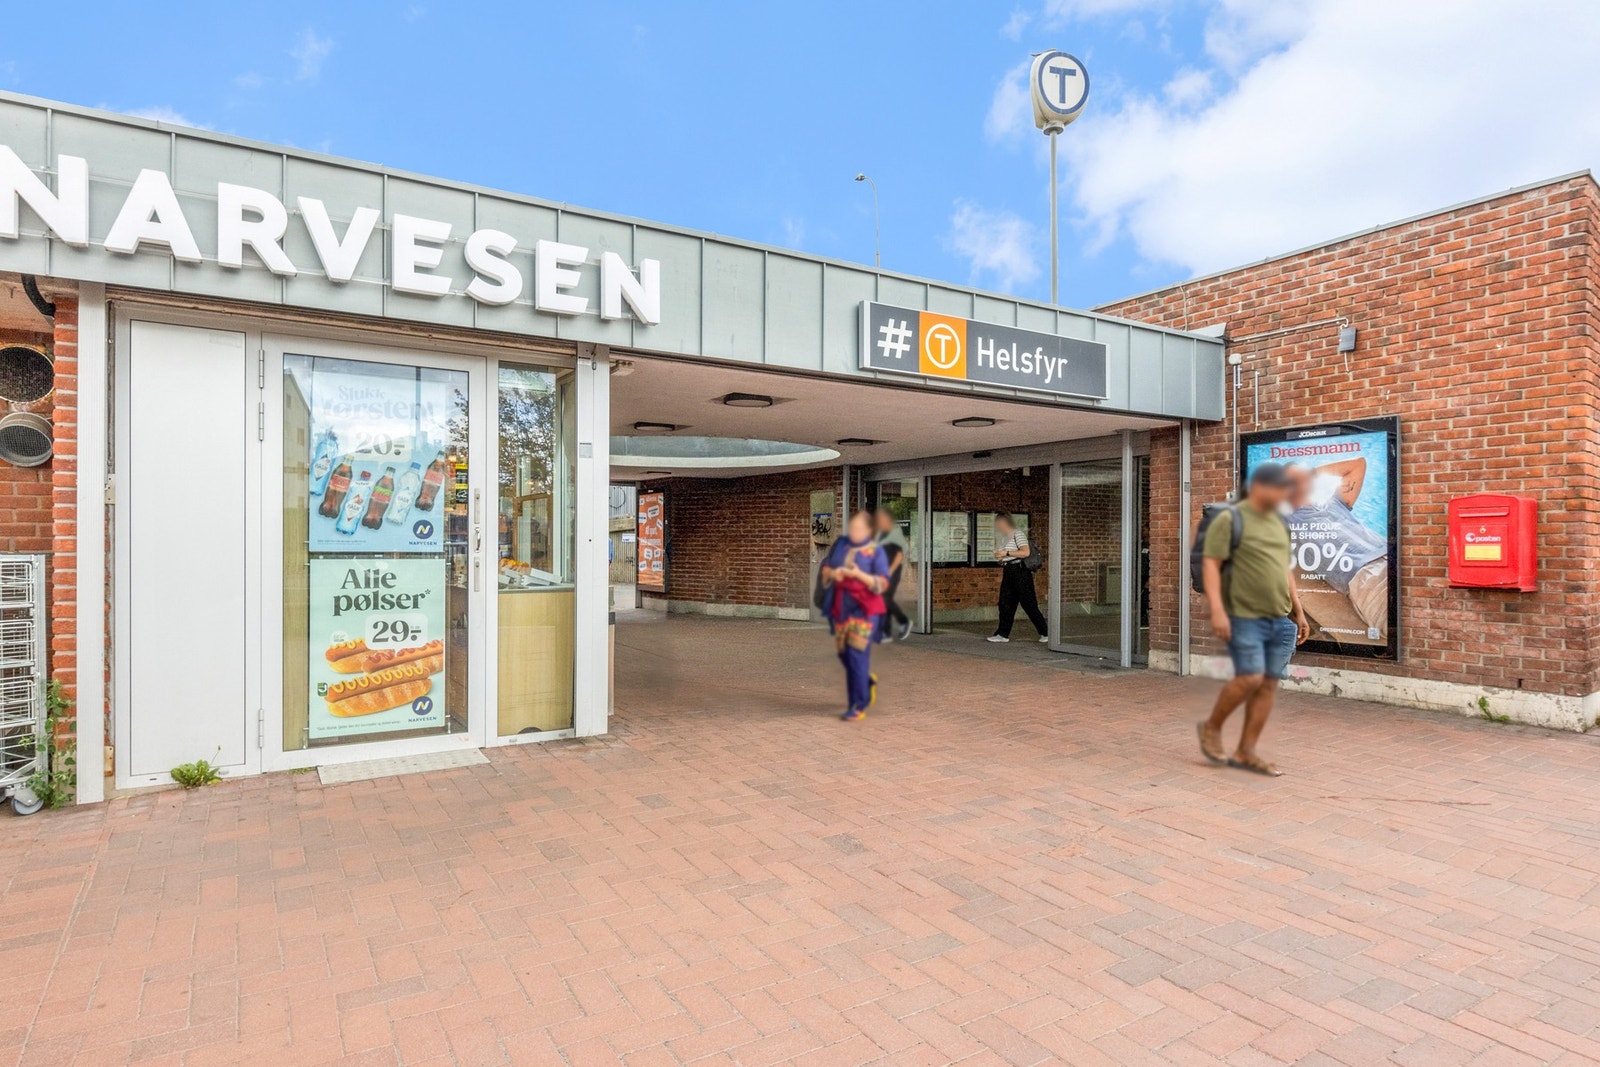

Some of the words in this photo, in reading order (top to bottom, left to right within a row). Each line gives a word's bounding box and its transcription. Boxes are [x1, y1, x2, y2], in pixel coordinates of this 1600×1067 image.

[1049, 65, 1077, 104] T
[0, 144, 661, 325] NARVESEN
[977, 336, 1068, 384] Helsfyr
[1270, 442, 1361, 459] Dressmann
[1299, 531, 1338, 540] SHORTS
[340, 568, 397, 590] Alle
